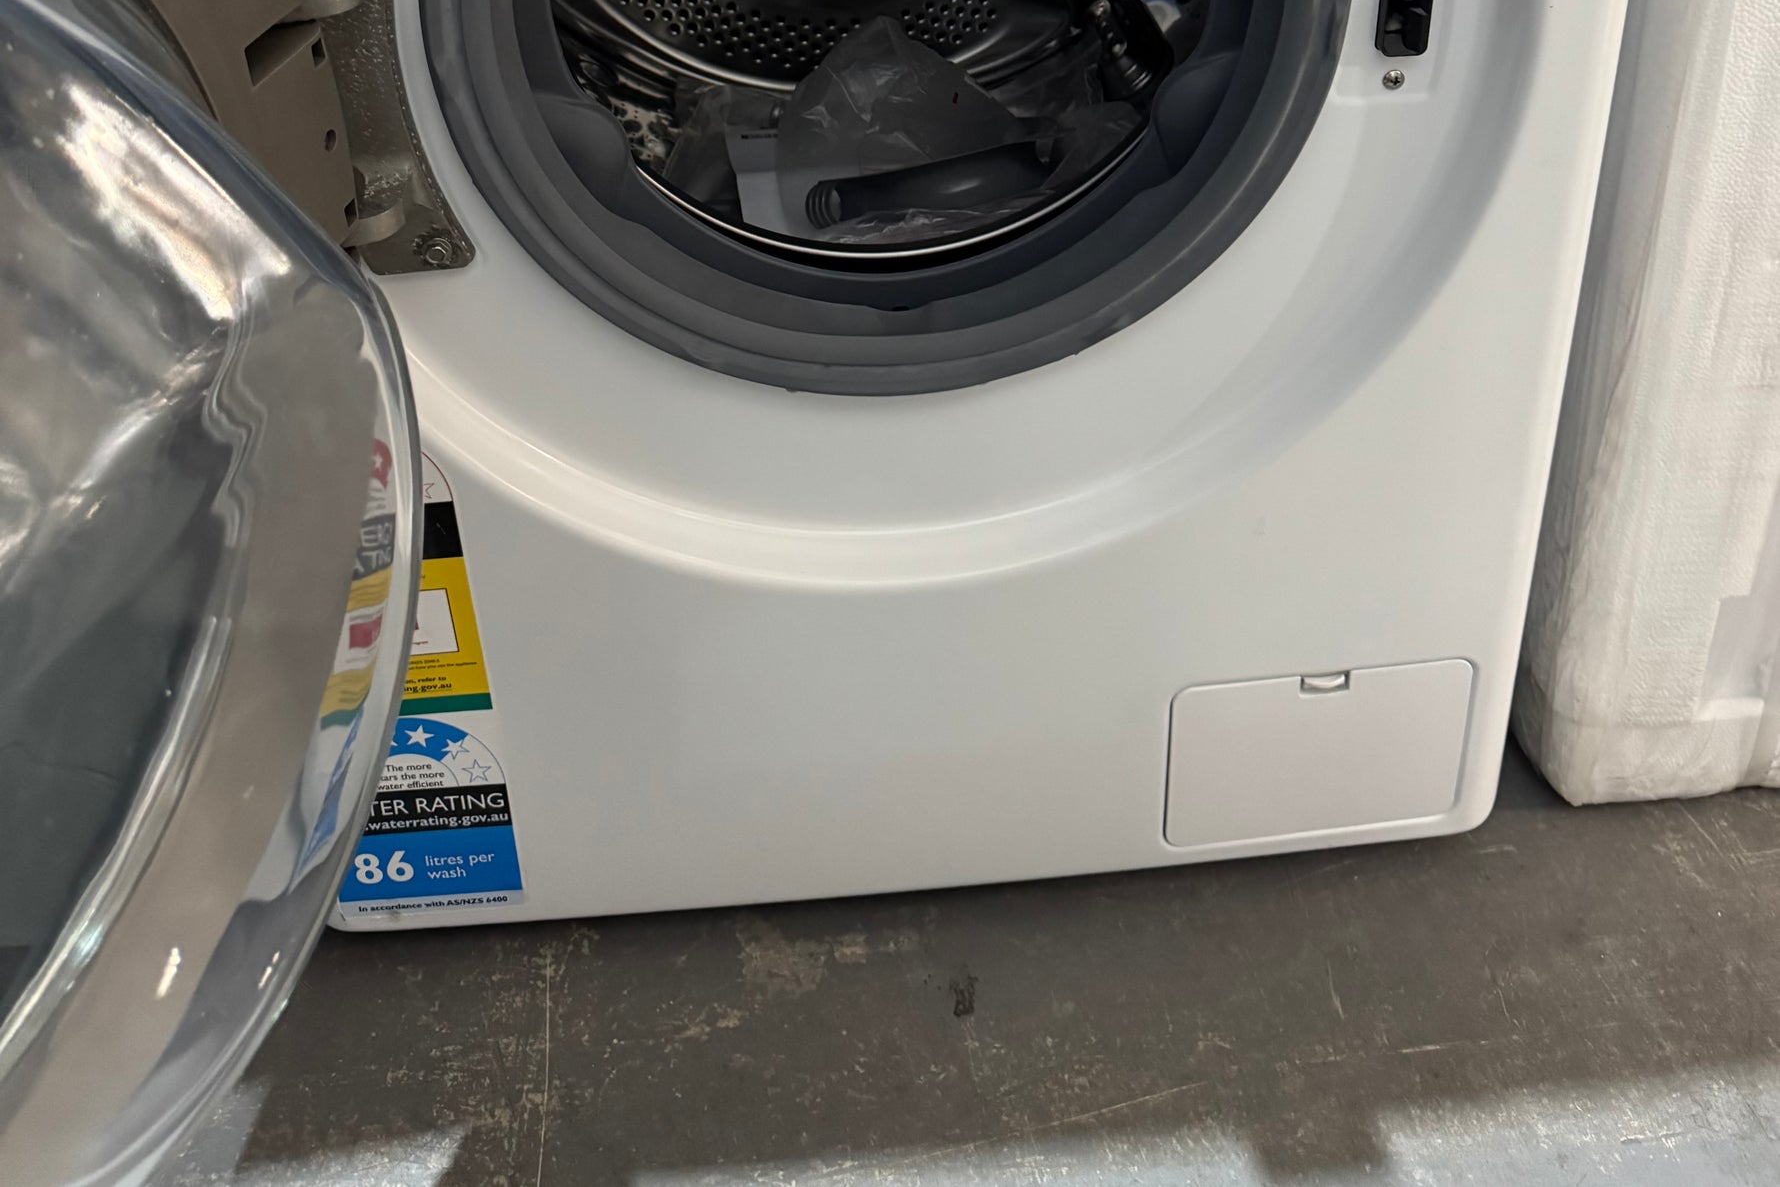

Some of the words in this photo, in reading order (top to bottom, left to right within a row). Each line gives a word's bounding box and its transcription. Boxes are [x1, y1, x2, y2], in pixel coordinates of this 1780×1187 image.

[386, 765, 403, 773] The
[406, 763, 432, 771] more
[407, 780, 444, 789] efficient
[370, 799, 409, 817] TER
[415, 793, 505, 814] RATING
[354, 850, 414, 884] 86
[425, 854, 464, 867] litres
[468, 853, 495, 867] per
[427, 866, 466, 880] wash
[370, 902, 423, 912] accordance
[424, 900, 445, 908] with
[446, 898, 484, 906] AS/NZS
